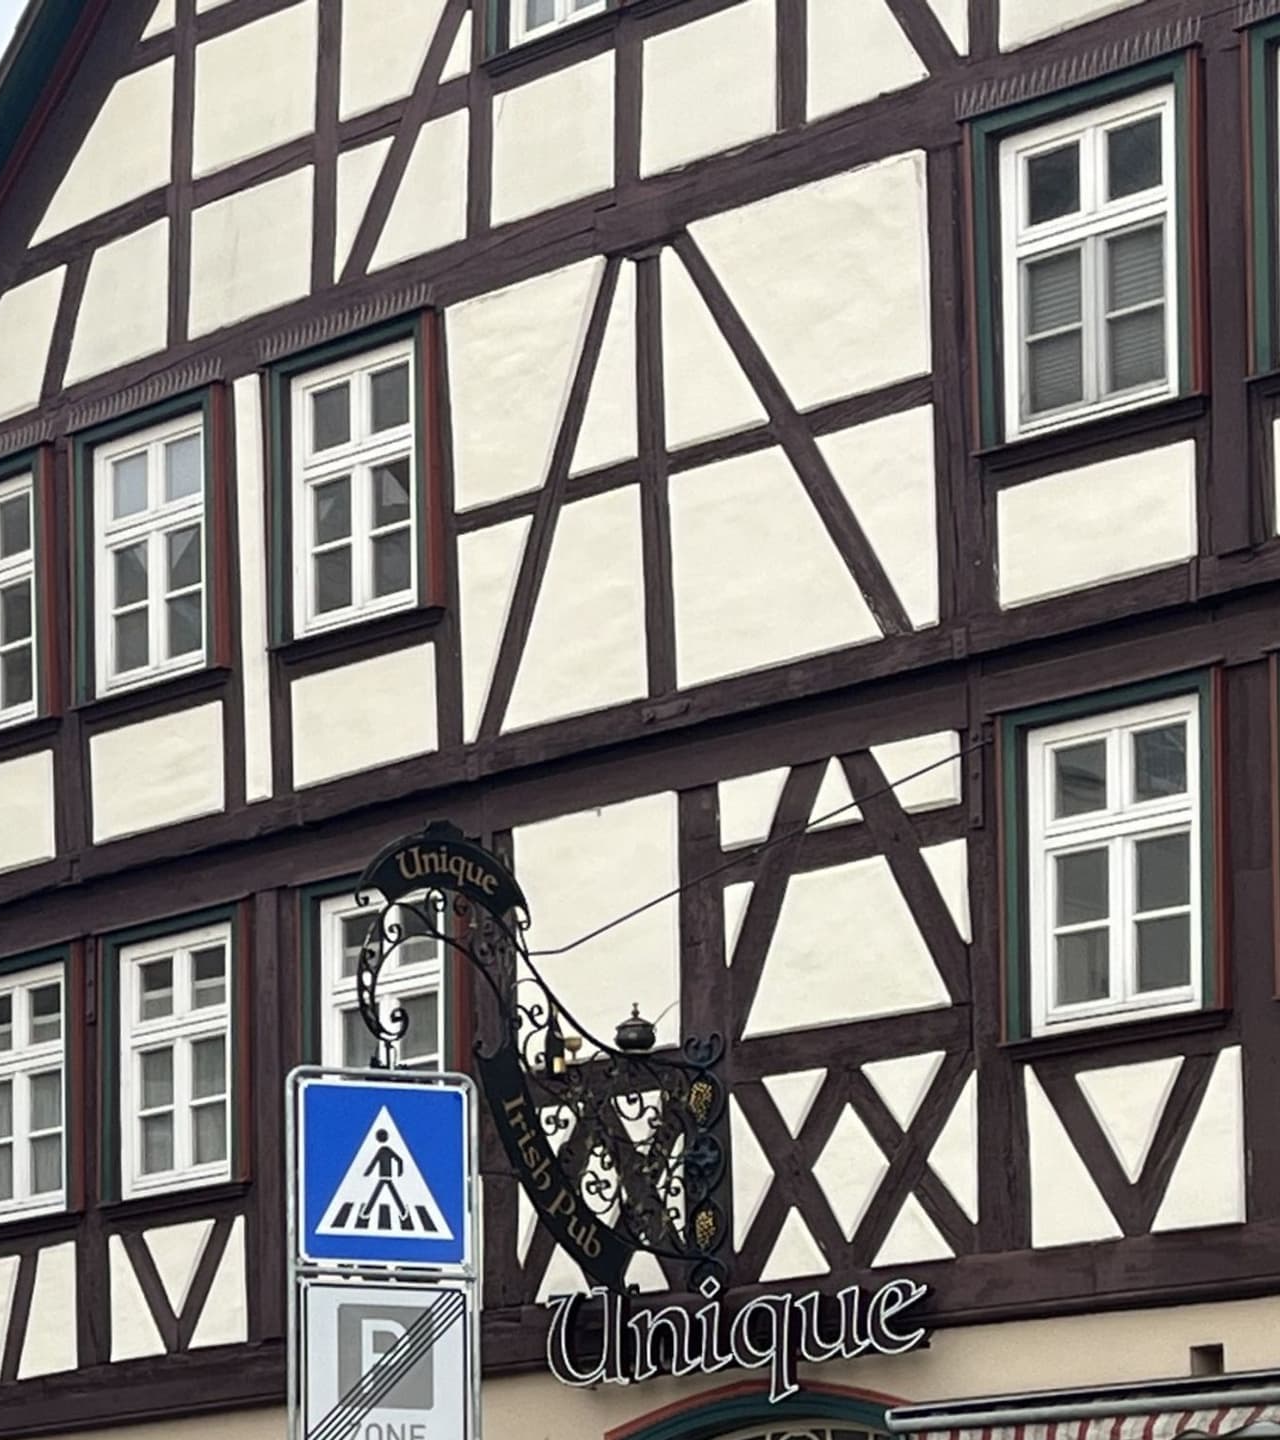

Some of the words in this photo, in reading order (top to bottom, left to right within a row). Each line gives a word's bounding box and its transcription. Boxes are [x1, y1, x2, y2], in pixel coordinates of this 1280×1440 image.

[395, 845, 499, 894] Unique
[503, 1095, 552, 1191] Irish
[546, 1188, 601, 1258] Pub
[546, 1276, 929, 1403] Unique
